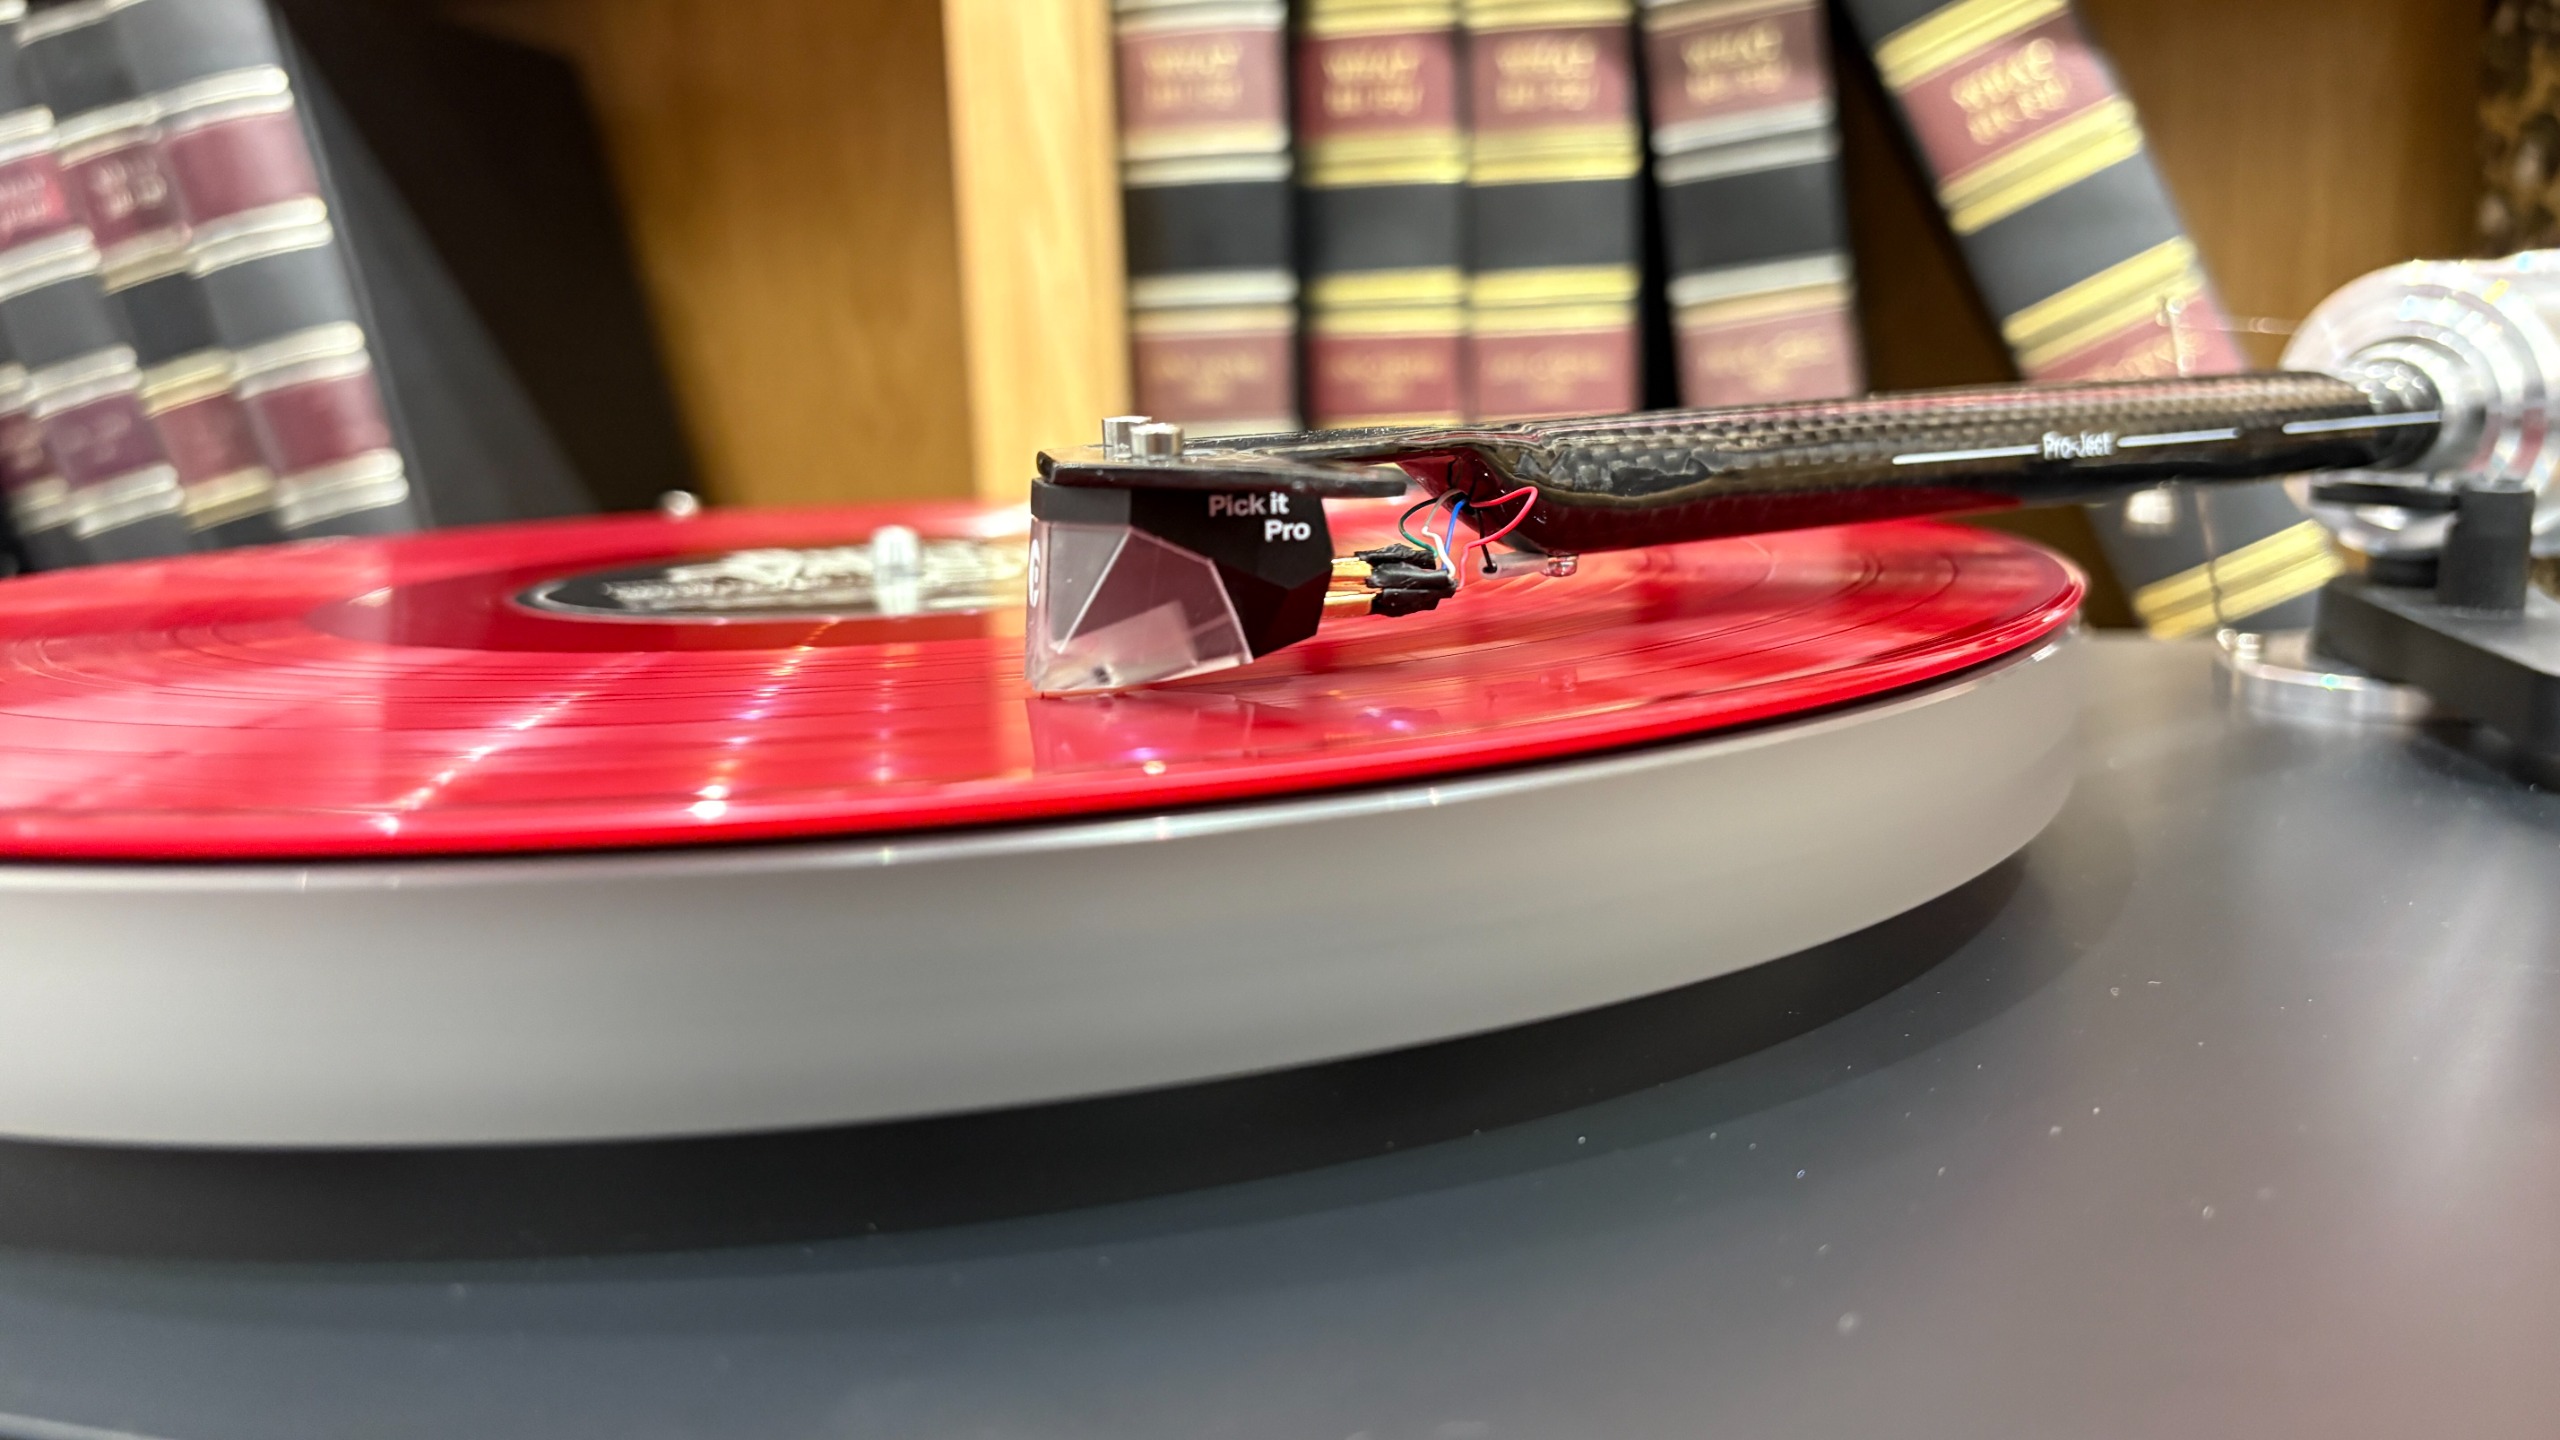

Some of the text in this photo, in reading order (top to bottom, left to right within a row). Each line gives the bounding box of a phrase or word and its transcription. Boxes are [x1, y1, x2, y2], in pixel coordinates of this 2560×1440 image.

[1208, 490, 1290, 517] Pick it
[1264, 519, 1311, 543] Pro
